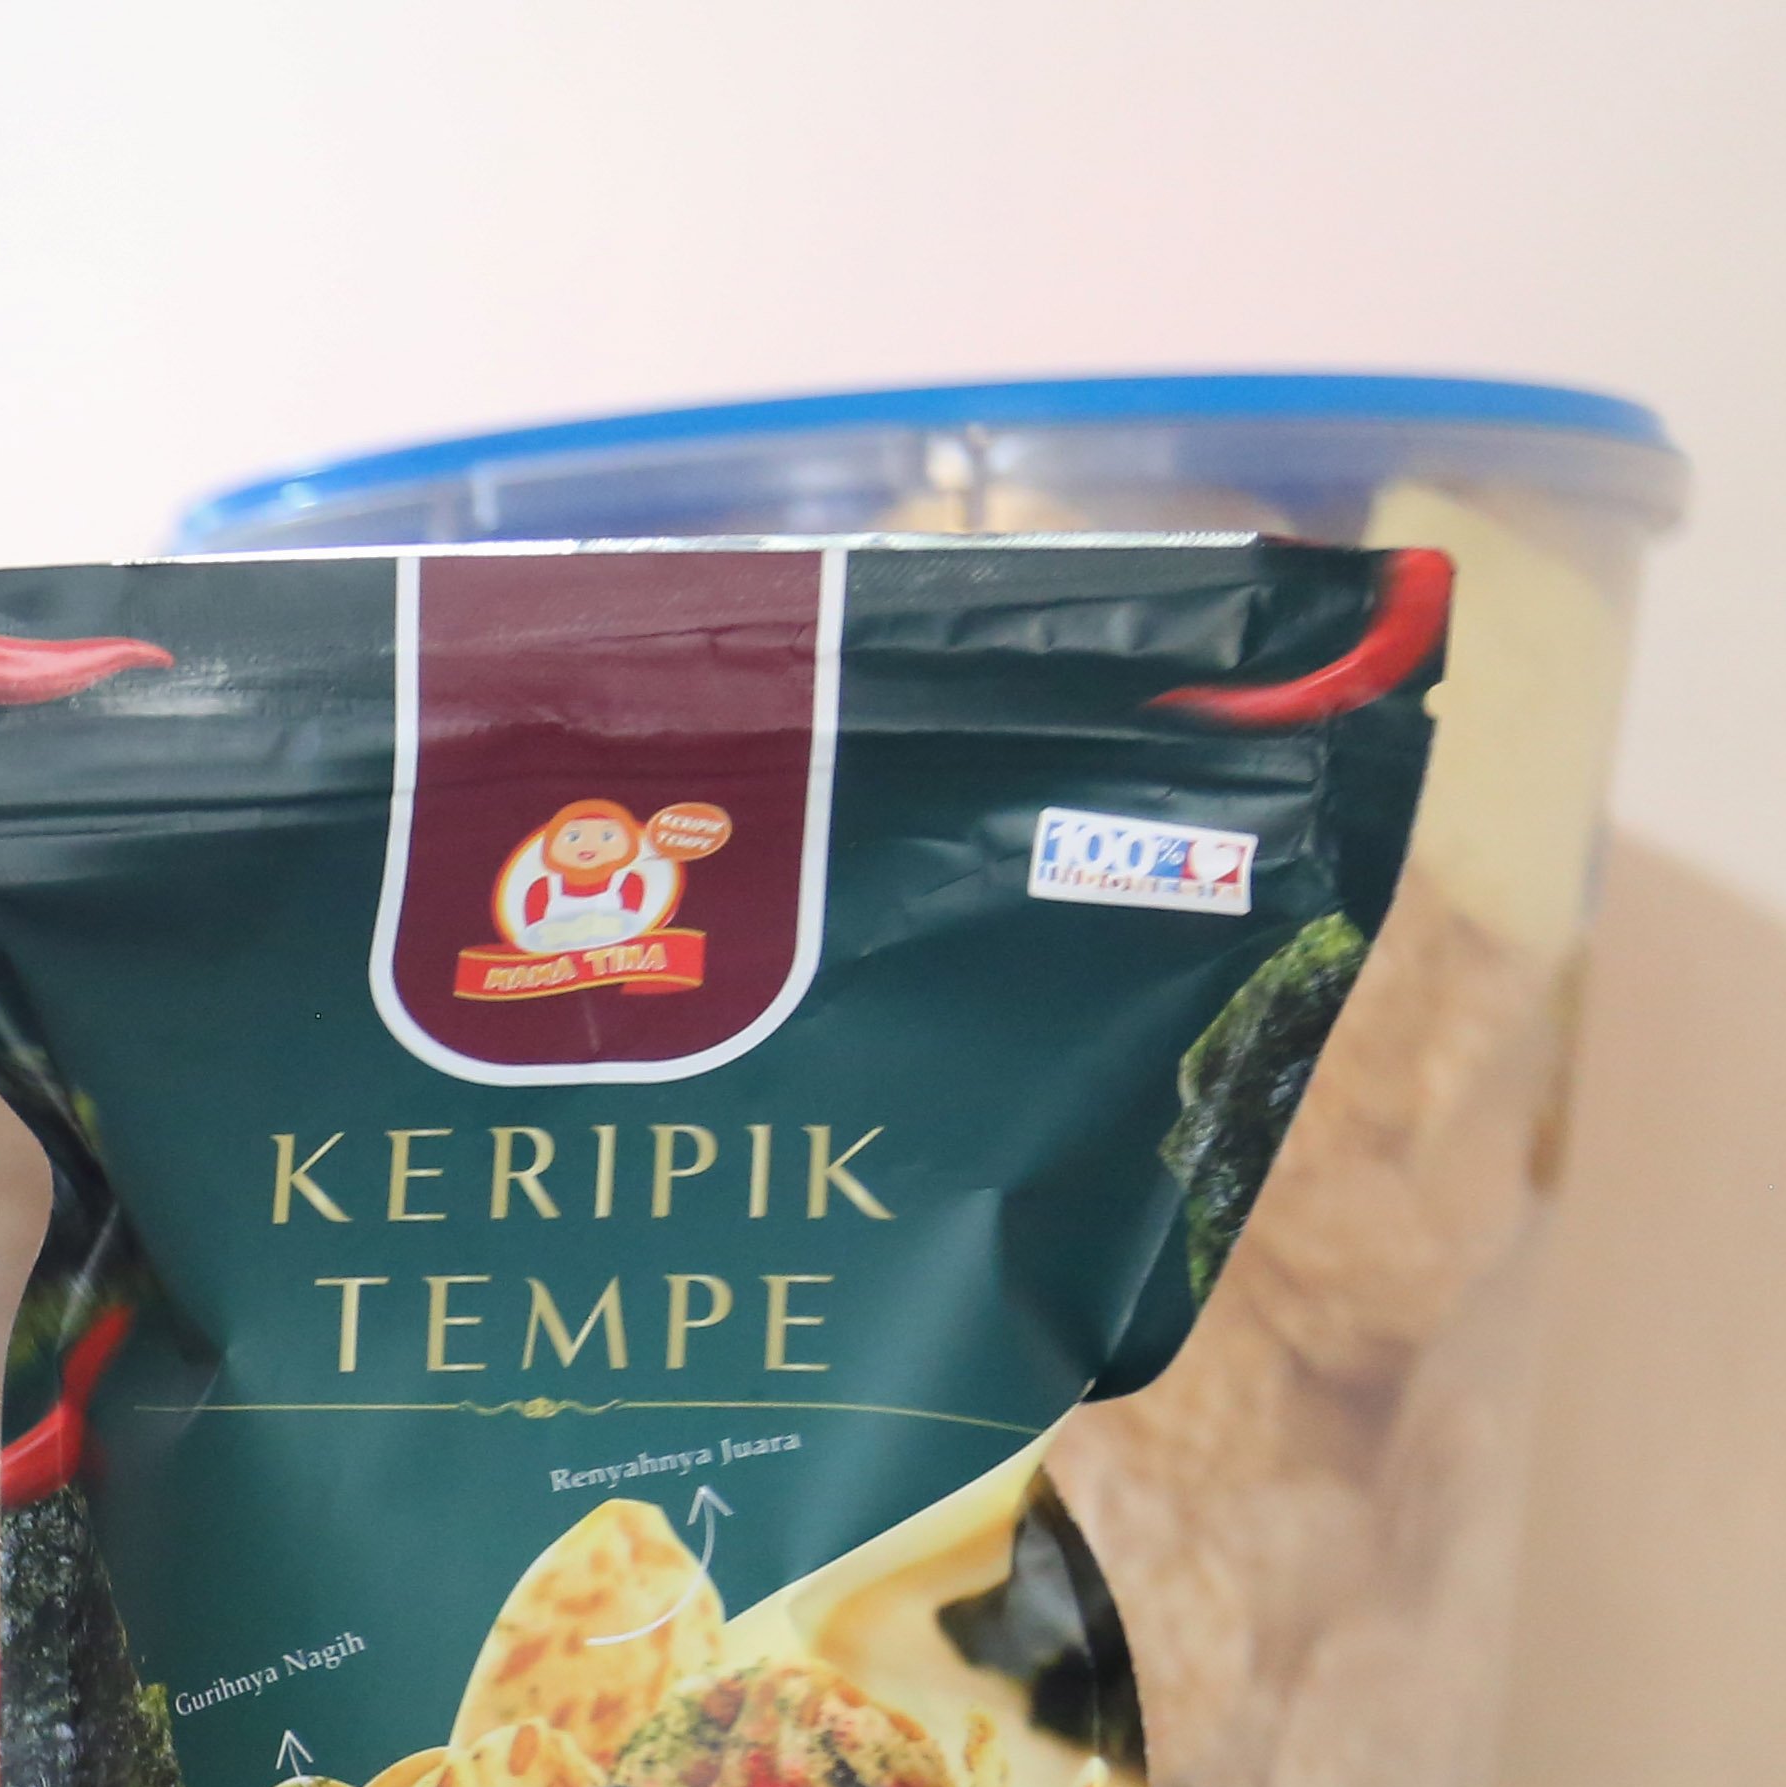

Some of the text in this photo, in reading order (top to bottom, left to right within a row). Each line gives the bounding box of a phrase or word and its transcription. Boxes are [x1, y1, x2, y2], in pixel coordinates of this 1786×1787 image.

[1044, 822, 1187, 874] 100%
[483, 943, 668, 991] MAMA TINA
[271, 1124, 896, 1224] KERIPIK
[314, 1274, 834, 1372] TEMPE
[551, 1430, 802, 1492] Renyahnya Juara
[175, 1631, 365, 1717] Gurihnya Nagih
